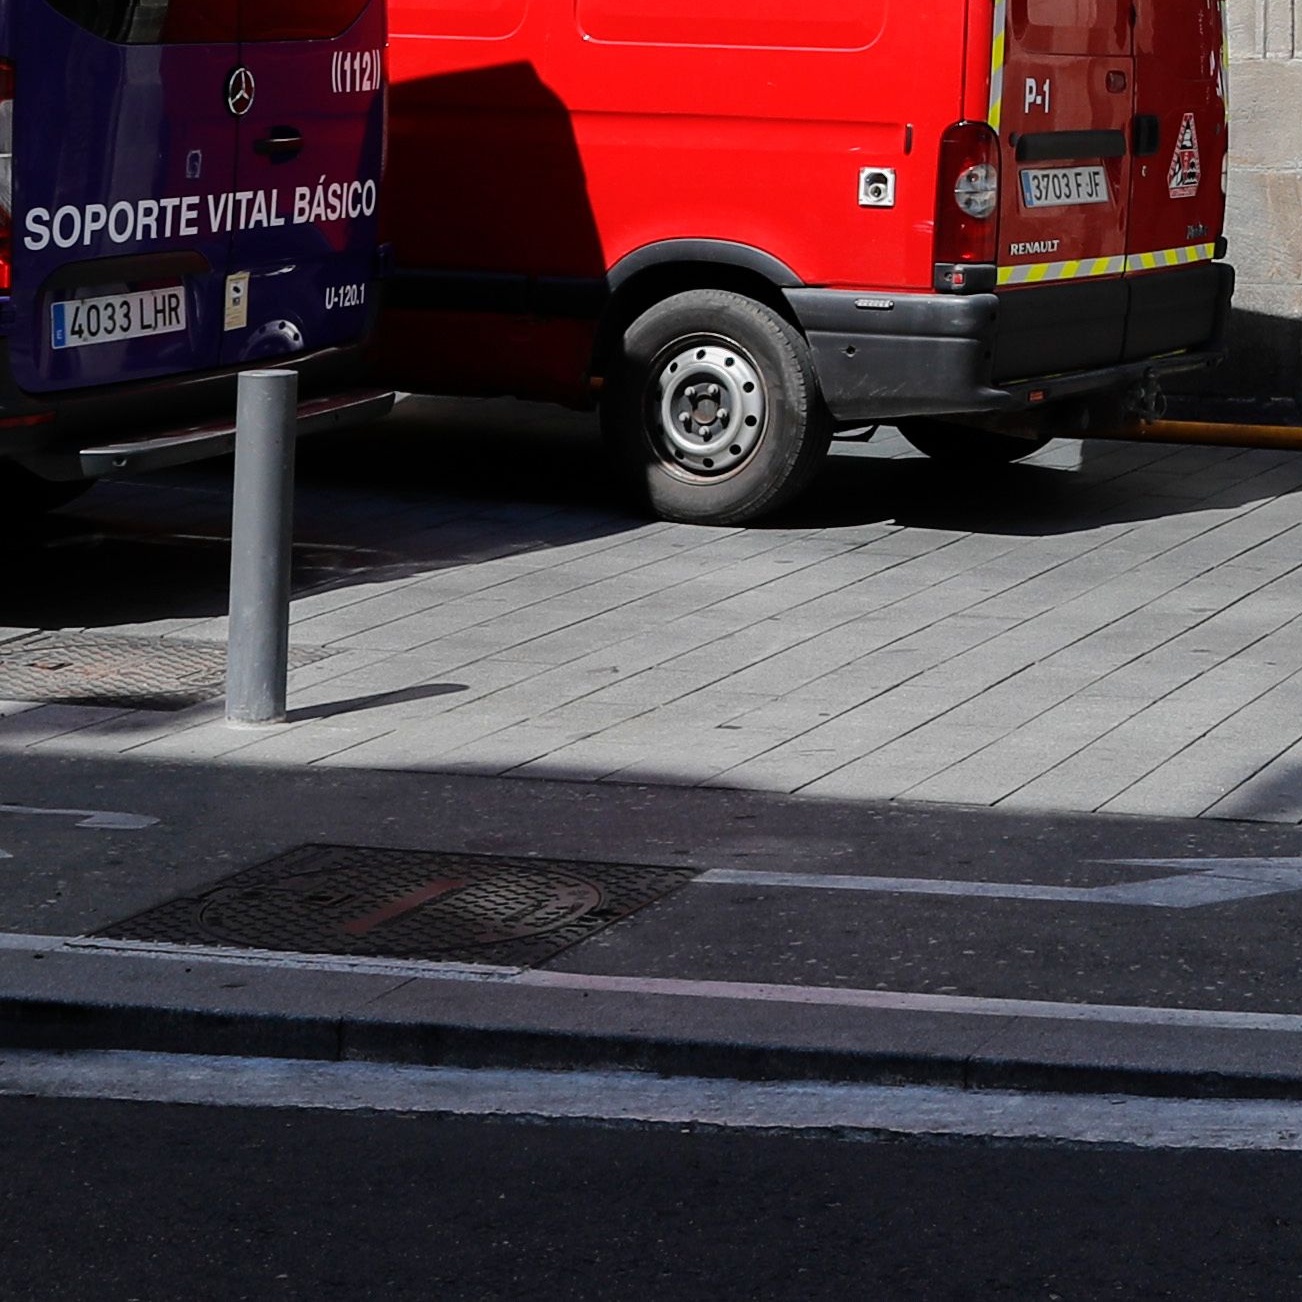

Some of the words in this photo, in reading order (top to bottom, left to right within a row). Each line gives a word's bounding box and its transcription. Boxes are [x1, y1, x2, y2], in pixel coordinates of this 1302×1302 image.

[1025, 78, 1050, 113] P-1
[1032, 173, 1071, 201] 3703
[1075, 171, 1100, 198] FJF
[25, 196, 198, 251] SOPORTE
[207, 188, 285, 233] VITAL
[294, 176, 376, 224] BÁSICO
[1010, 240, 1060, 255] RENAULT
[325, 283, 365, 310] U-120.1
[70, 300, 131, 339] 4033
[140, 293, 180, 330] LHR
